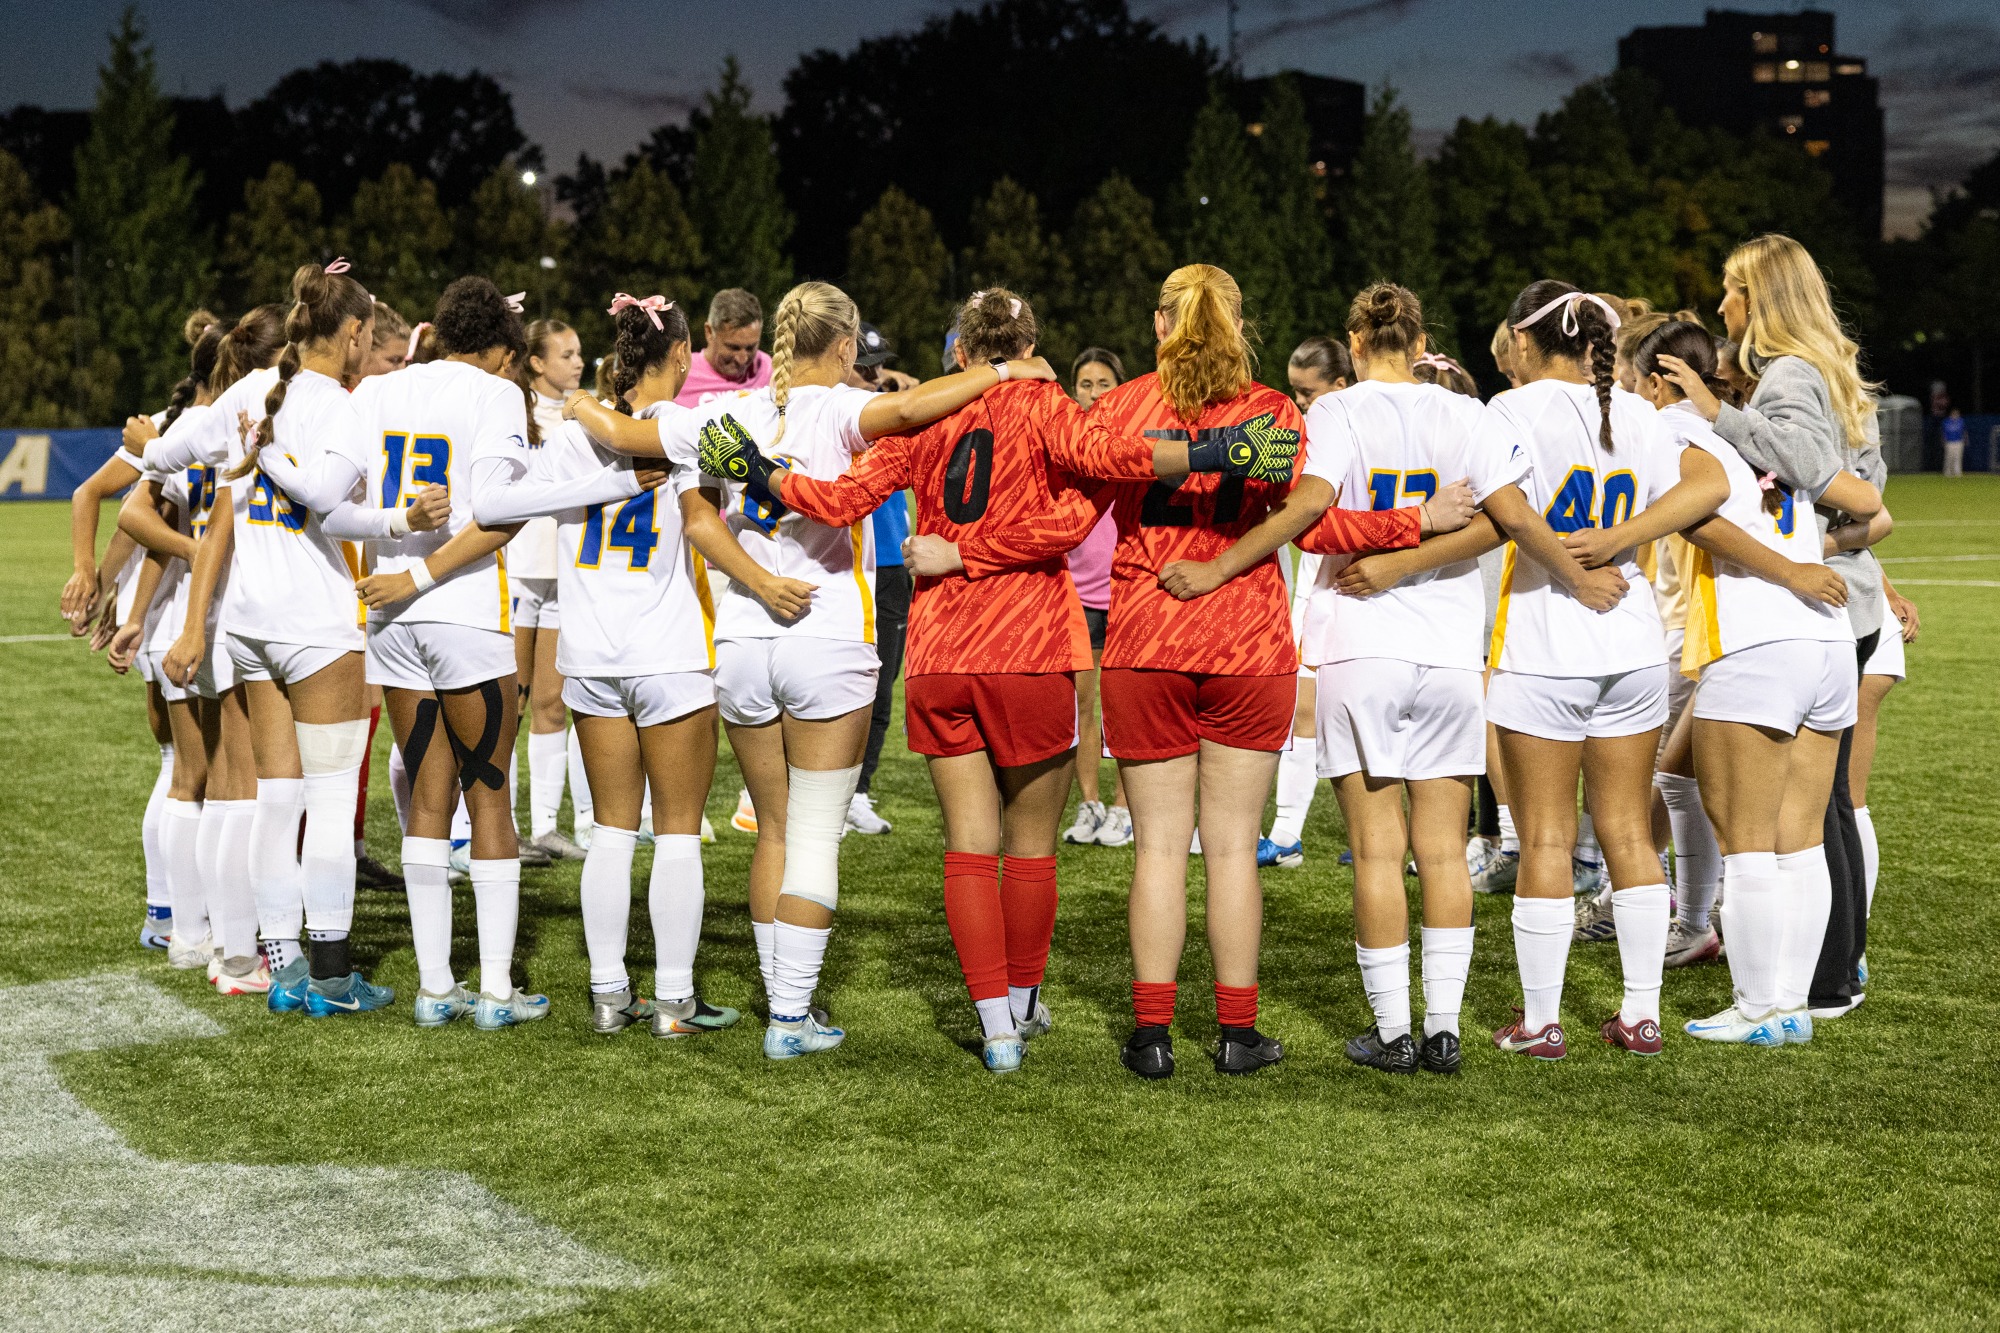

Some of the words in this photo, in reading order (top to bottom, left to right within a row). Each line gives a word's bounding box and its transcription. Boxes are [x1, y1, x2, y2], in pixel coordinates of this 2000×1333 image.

[0, 434, 50, 496] A
[380, 431, 453, 509] 13
[944, 428, 994, 525] 0
[1543, 464, 1638, 538] 40
[575, 487, 661, 572] 14
